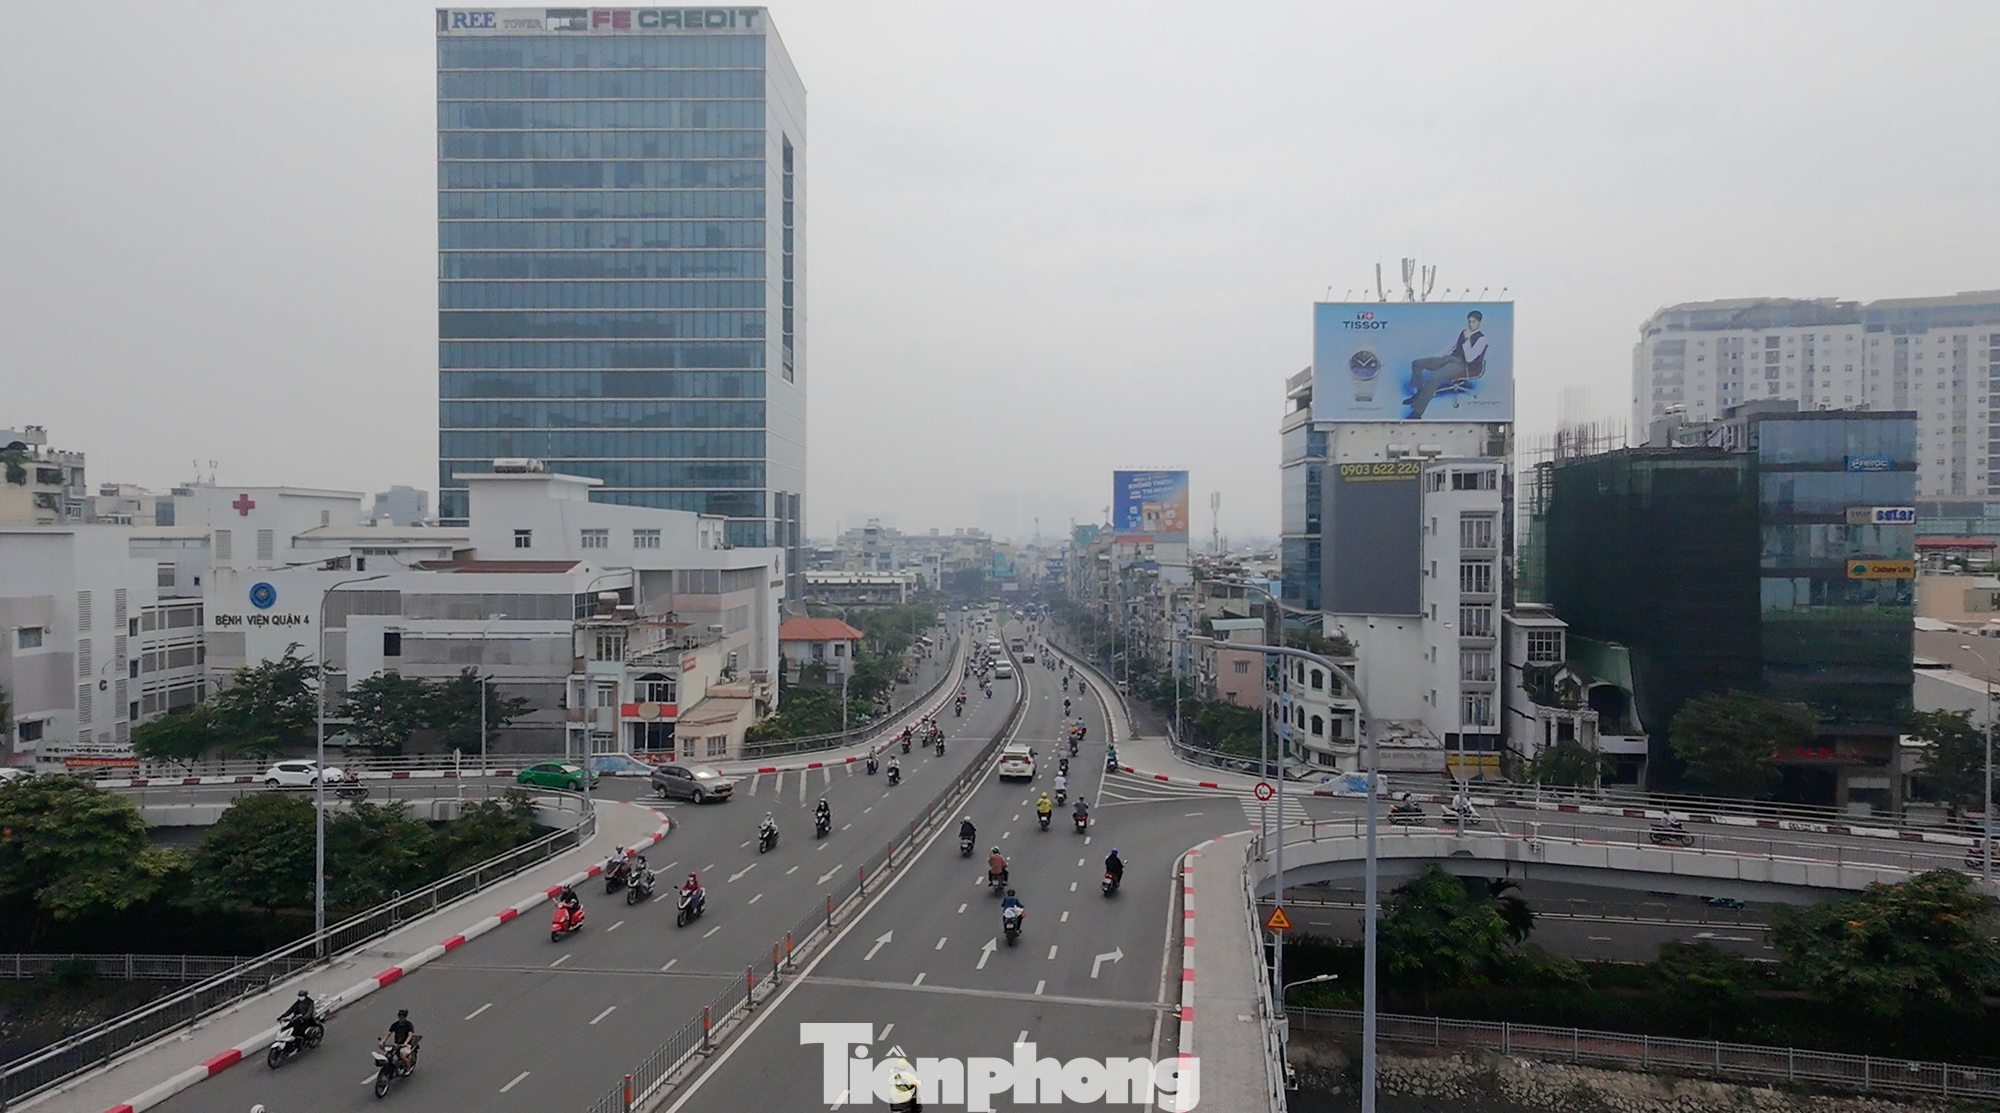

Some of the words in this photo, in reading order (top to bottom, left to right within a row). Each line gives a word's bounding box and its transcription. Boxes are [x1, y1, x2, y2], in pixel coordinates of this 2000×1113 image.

[452, 11, 496, 28] REE
[503, 19, 542, 29] TOWER
[592, 10, 631, 28] FE
[638, 10, 759, 28] CREDIT
[1343, 321, 1388, 330] TISSOT
[1340, 464, 1370, 476] 0903
[1372, 463, 1395, 475] 622
[1397, 462, 1420, 474] 226
[215, 613, 243, 628] BỆNH
[246, 613, 270, 629] VIỆN
[271, 613, 301, 628] QUẬN
[303, 615, 310, 625] 4
